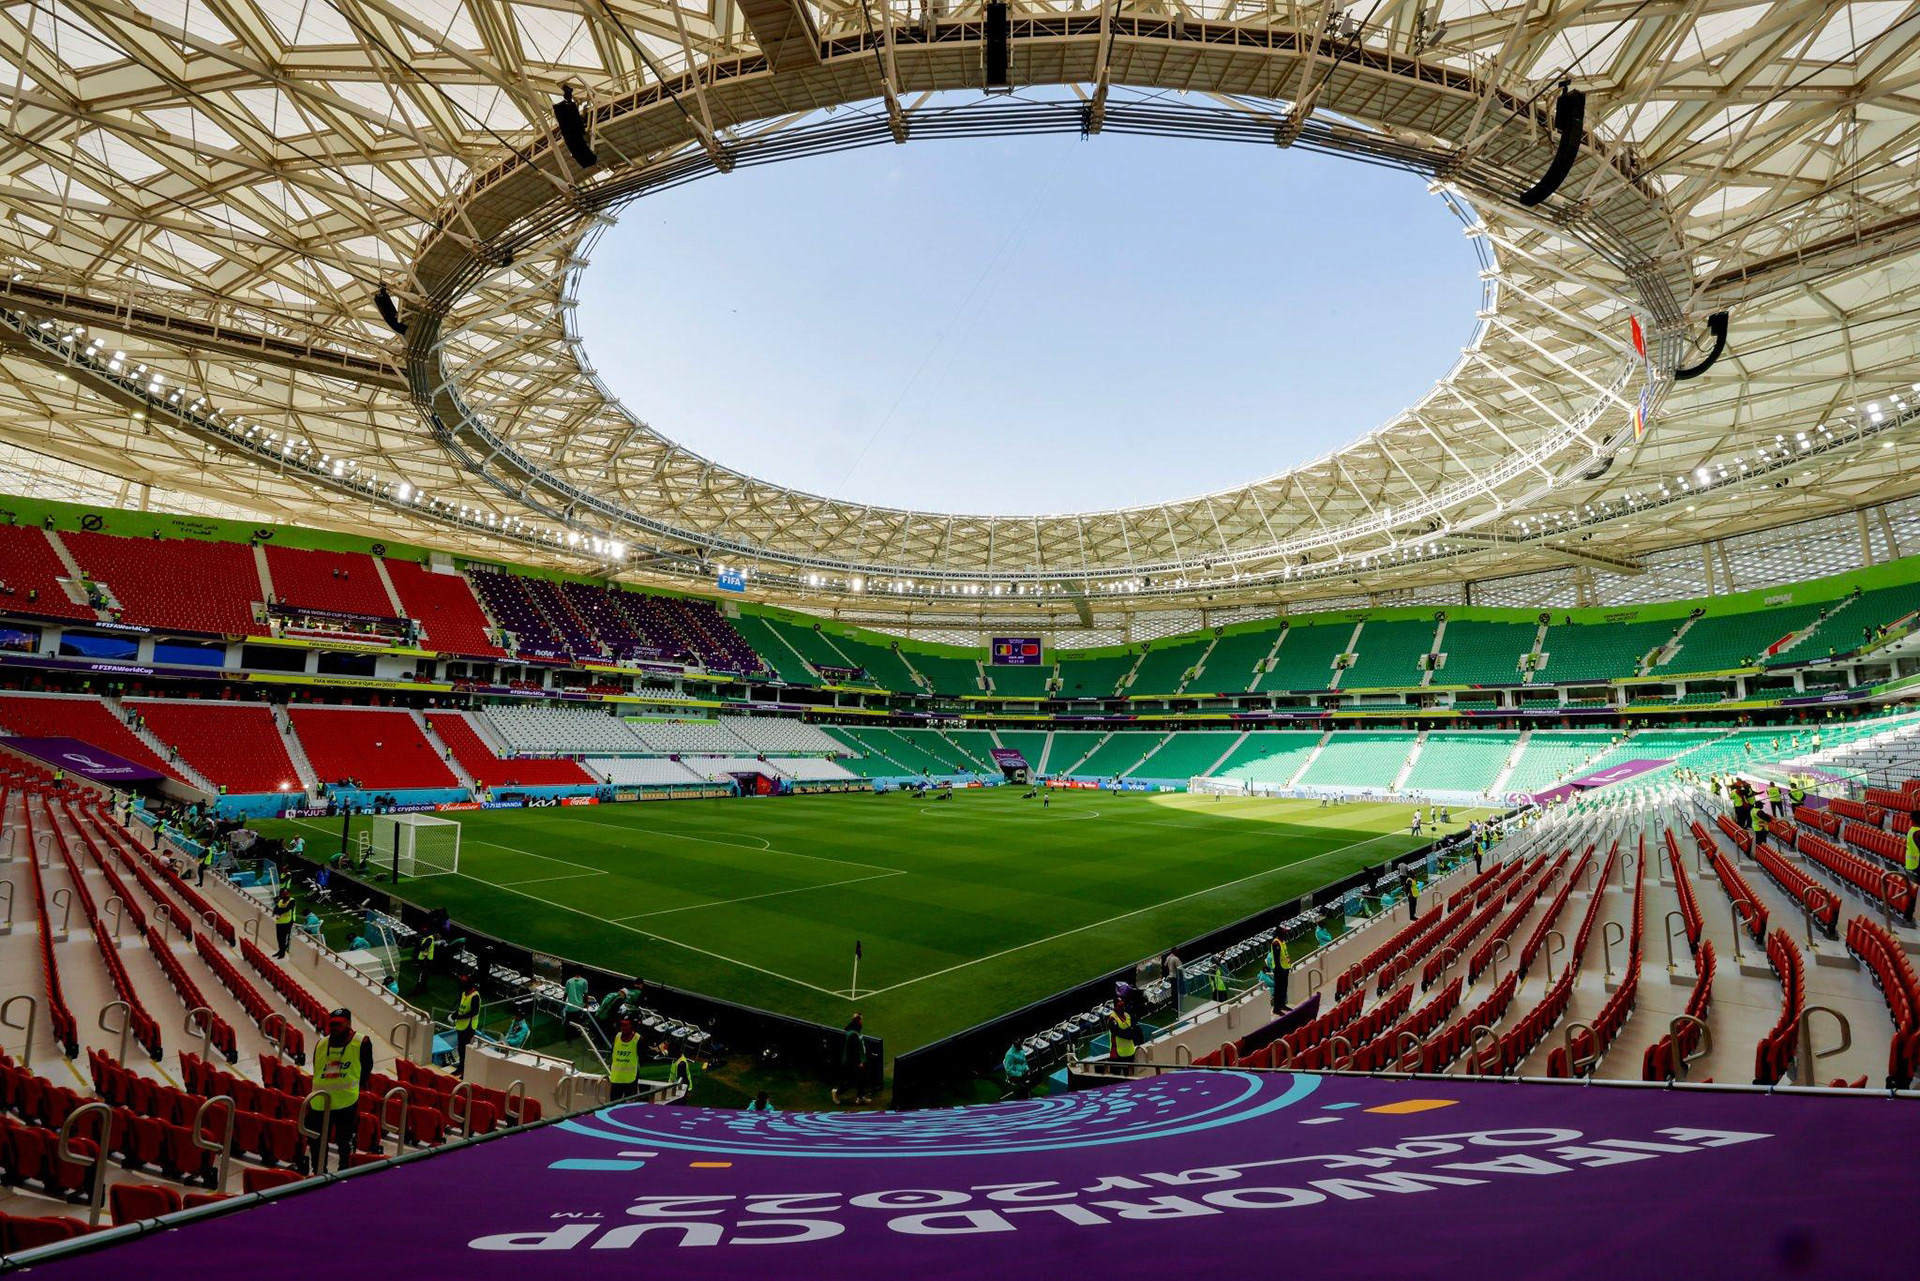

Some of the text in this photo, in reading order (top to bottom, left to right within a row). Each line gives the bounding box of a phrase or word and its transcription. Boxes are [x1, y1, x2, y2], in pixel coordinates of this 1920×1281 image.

[722, 575, 741, 586] FIFA
[95, 621, 151, 633] #FIFAWorldCup
[535, 649, 555, 657] now
[91, 664, 154, 674] #FIFAWorldCup
[1355, 795, 1383, 803] QATAR
[397, 804, 435, 812] crypto.com
[440, 803, 479, 811] Budweiser
[467, 1127, 1776, 1250] FIFA WORLD CUP
